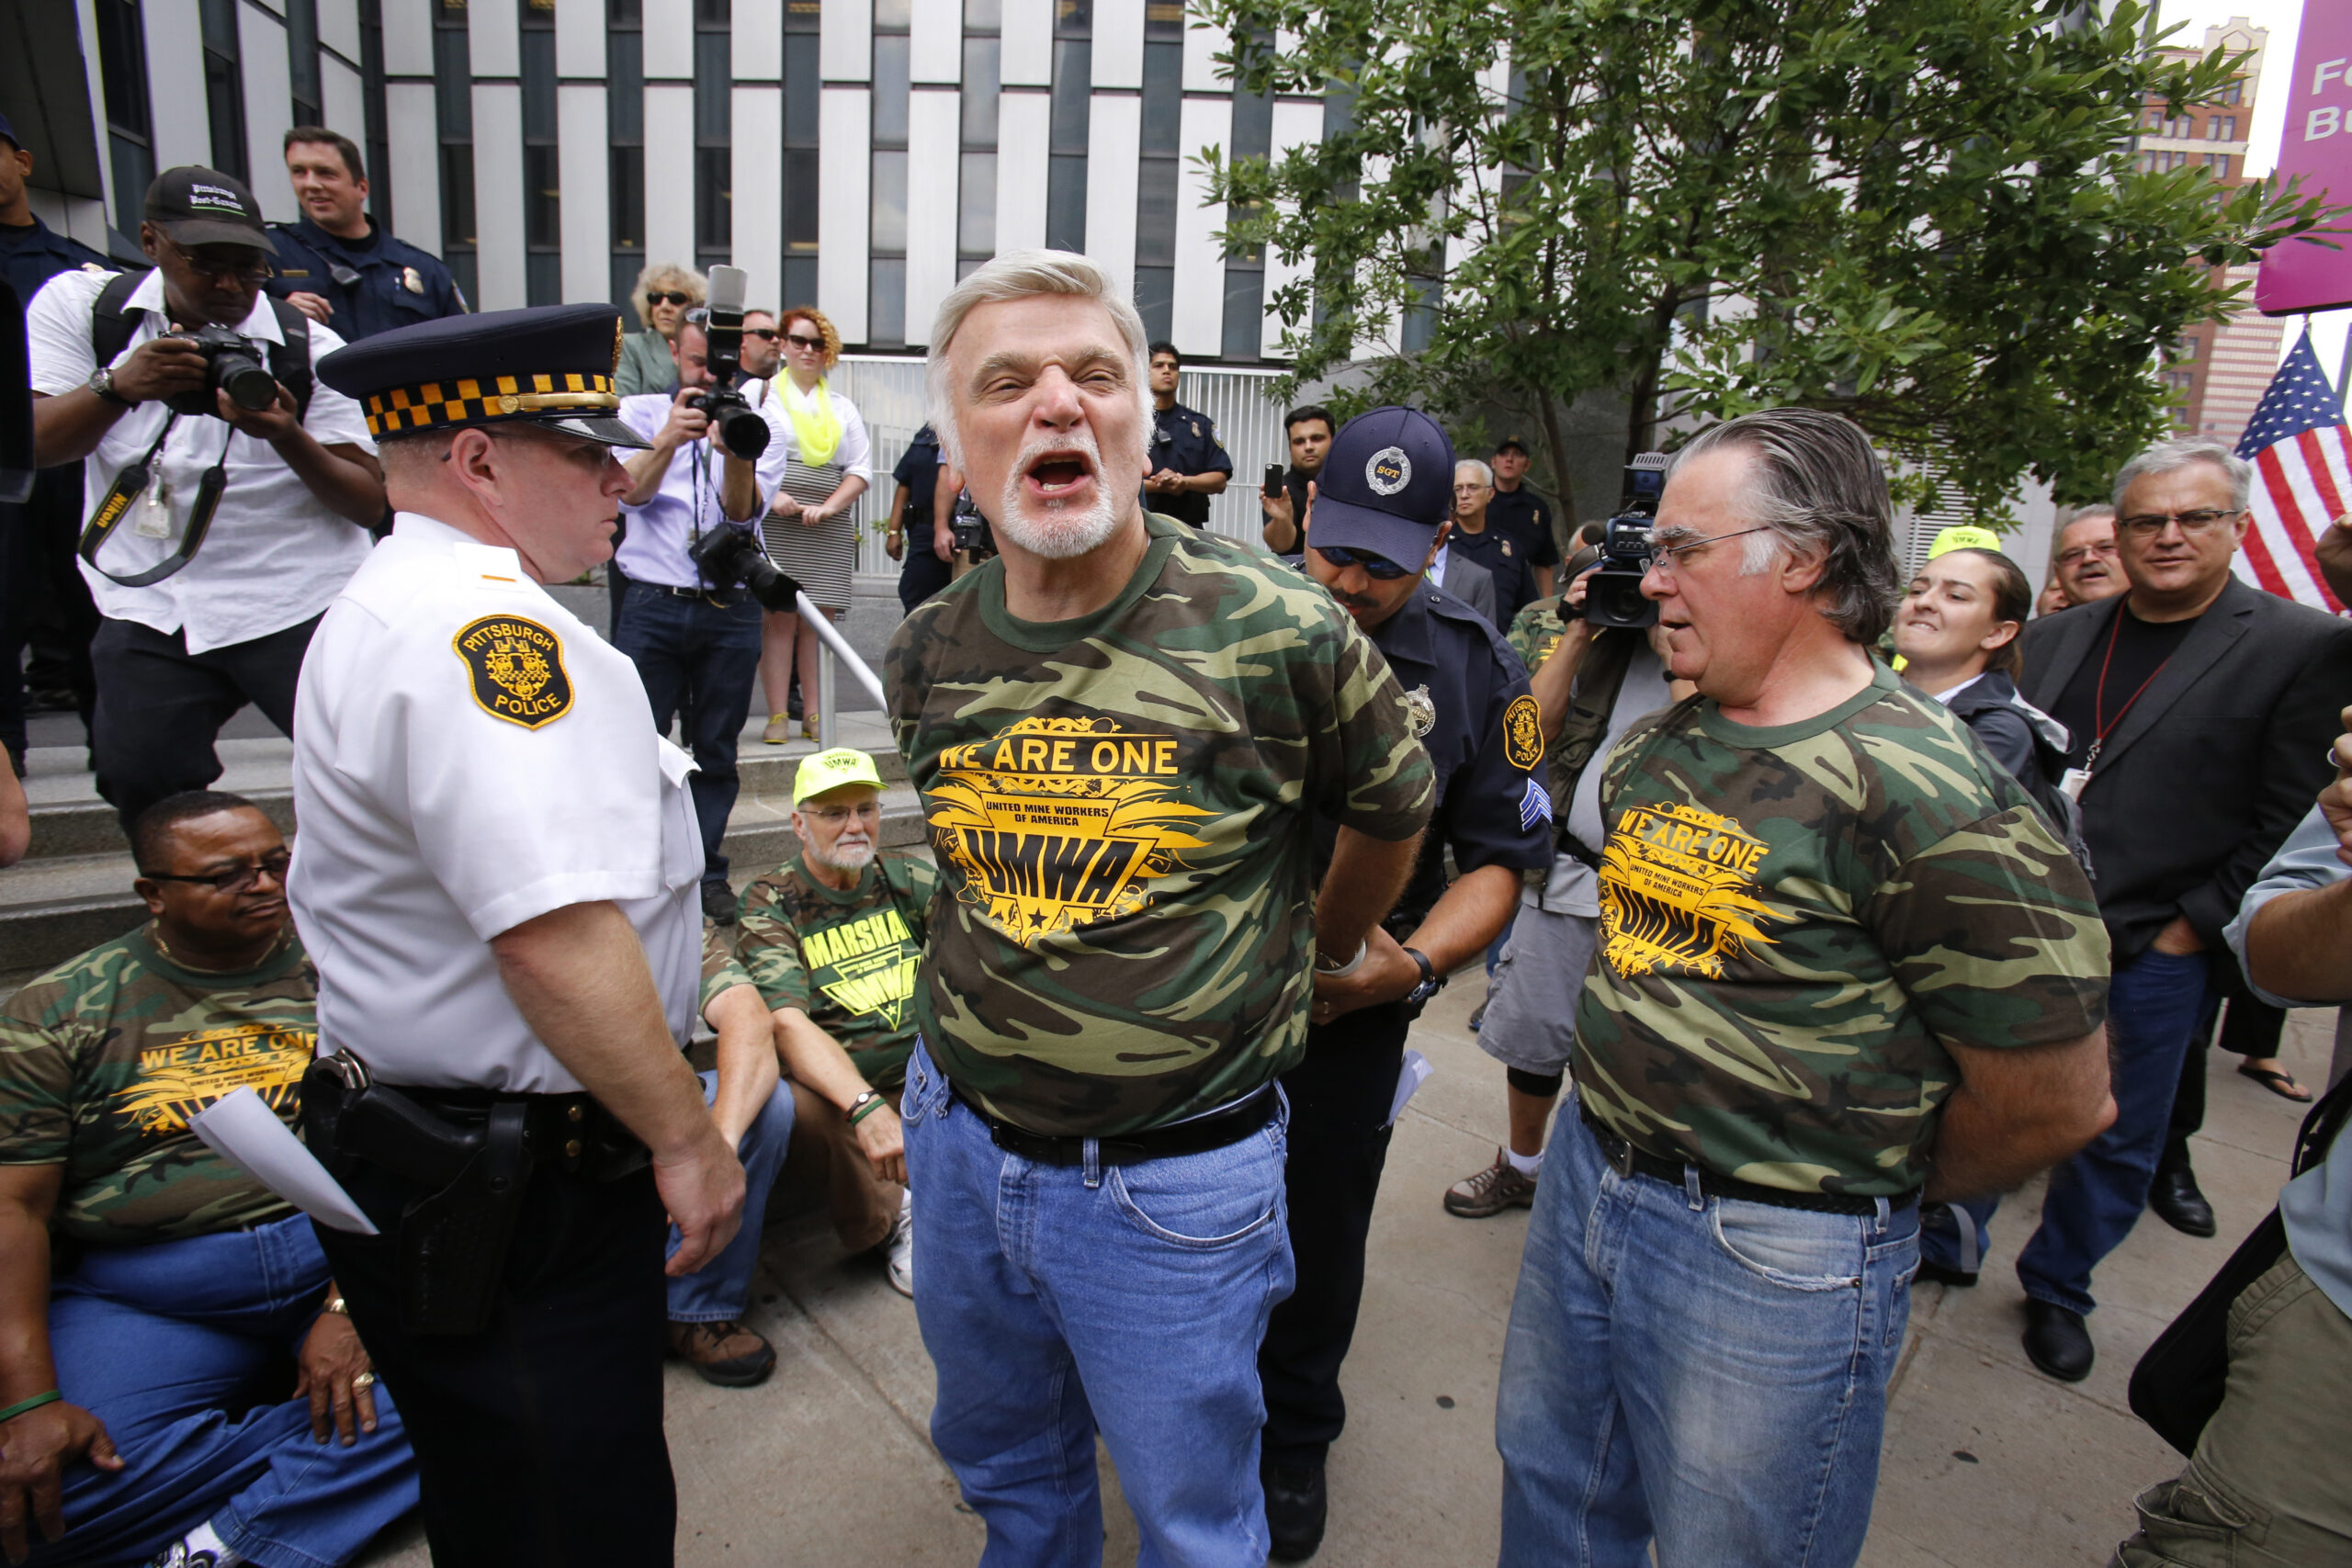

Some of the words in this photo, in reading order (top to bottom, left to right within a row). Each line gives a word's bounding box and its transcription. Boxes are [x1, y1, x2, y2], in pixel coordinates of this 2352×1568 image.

[1377, 466, 1399, 479] SGT
[96, 492, 128, 528] Nikon
[463, 624, 554, 651] PITTSBURGH
[494, 693, 561, 716] POLICE
[823, 757, 856, 768] UMWA
[939, 743, 988, 770] WE
[993, 739, 1077, 772] ARE
[1091, 740, 1179, 774] ONE
[1515, 744, 1540, 761] POLICE
[986, 801, 1021, 812] UNITED
[1024, 804, 1050, 814] MINE
[1054, 806, 1109, 818] WORKERS
[1014, 814, 1026, 823] OF
[1031, 815, 1080, 827] AMERICA
[1616, 809, 1654, 838] WE
[1653, 821, 1709, 855] ARE
[1707, 837, 1770, 874] ONE
[965, 829, 1138, 905] UMWA
[1630, 864, 1653, 877] UNITED
[1654, 873, 1671, 884] MINE
[1672, 879, 1704, 897] WORKERS
[1644, 878, 1652, 886] OF
[1653, 882, 1682, 898] AMERICA
[1611, 882, 1717, 959] UMWA
[831, 960, 915, 1010] UMWA
[141, 1046, 188, 1069] WE
[198, 1036, 260, 1063] ARE
